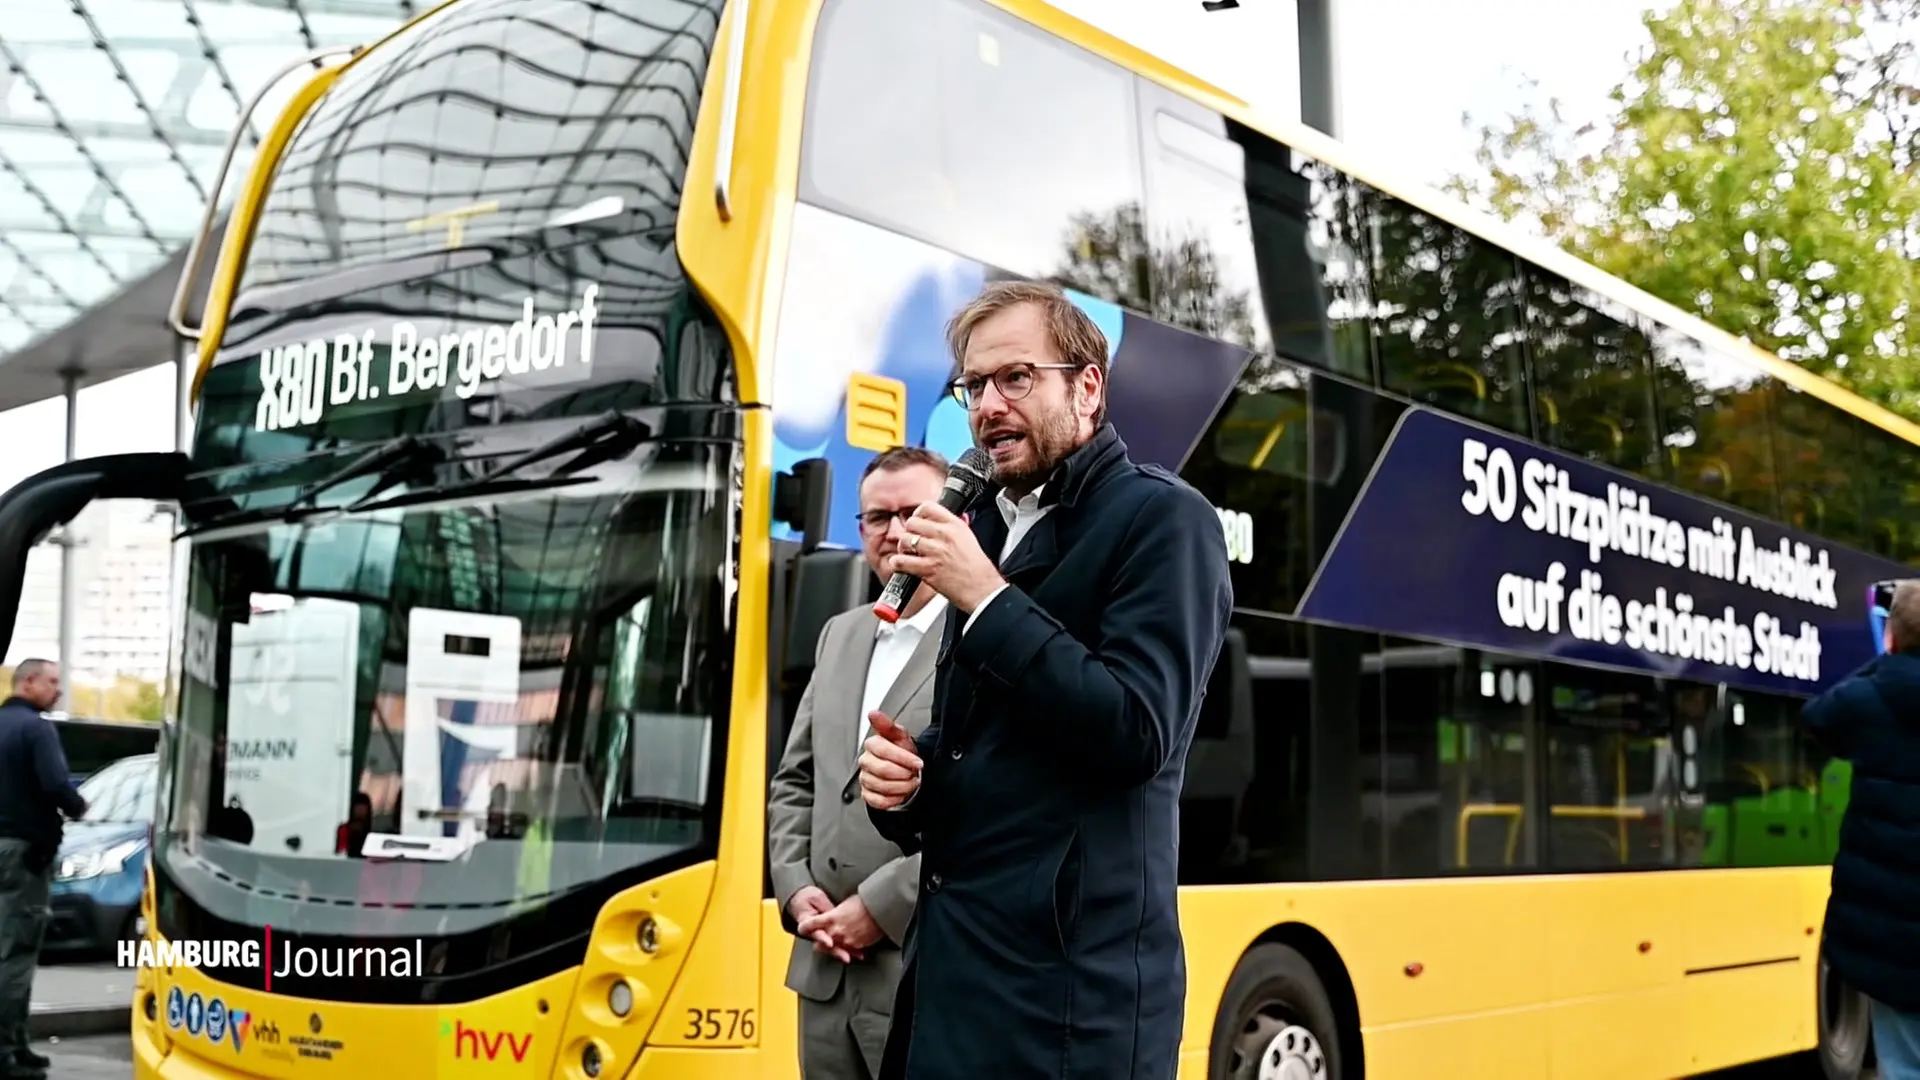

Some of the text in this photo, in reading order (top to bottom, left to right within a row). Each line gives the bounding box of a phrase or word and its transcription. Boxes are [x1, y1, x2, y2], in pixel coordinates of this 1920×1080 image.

[255, 283, 599, 432] X80 Bf. Bergedorf
[1215, 506, 1253, 565] 80
[1462, 438, 1838, 609] 50 Sitzplätze mit Ausblick
[1497, 561, 1822, 682] auf die schönste Stadt
[253, 1018, 281, 1044] vhh
[456, 1019, 533, 1063] hvv
[684, 1007, 754, 1040] 3576
